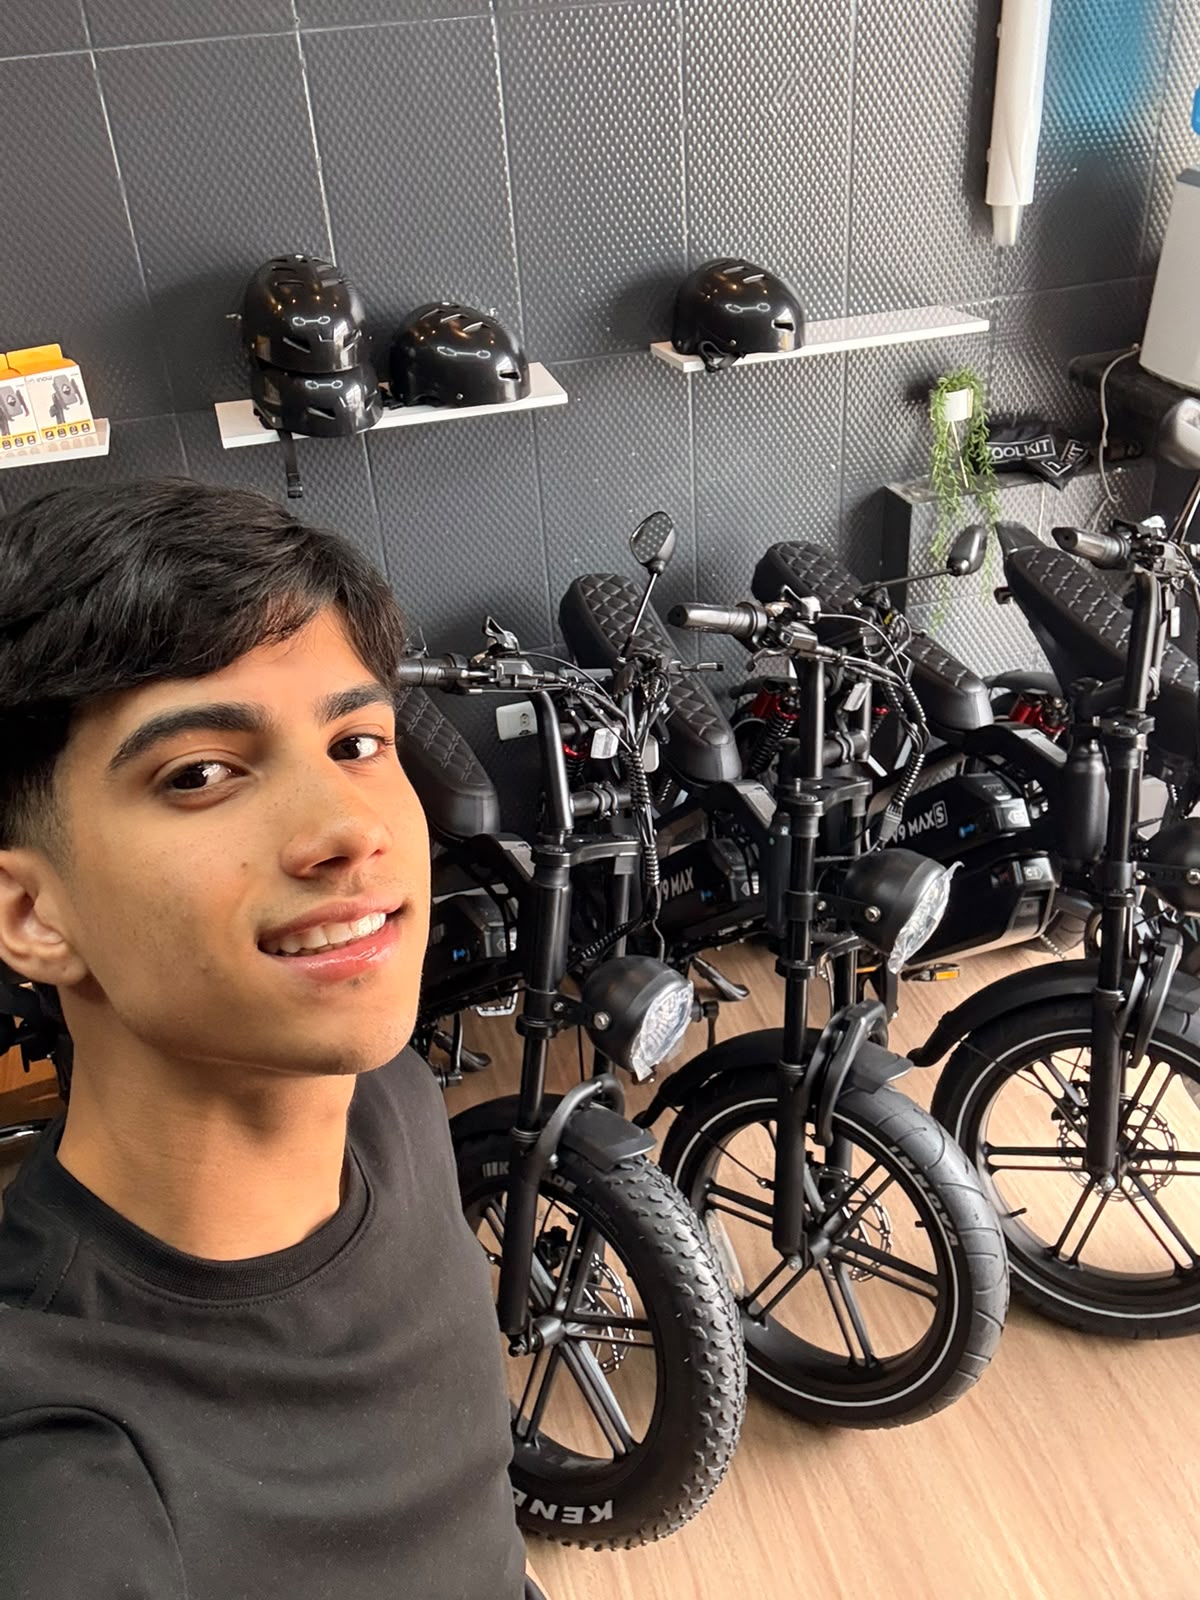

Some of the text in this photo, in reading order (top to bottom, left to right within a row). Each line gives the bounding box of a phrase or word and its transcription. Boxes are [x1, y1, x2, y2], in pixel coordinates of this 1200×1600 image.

[986, 439, 1050, 459] OOLKIT
[670, 866, 694, 898] MAX
[888, 1145, 960, 1247] INNOVA
